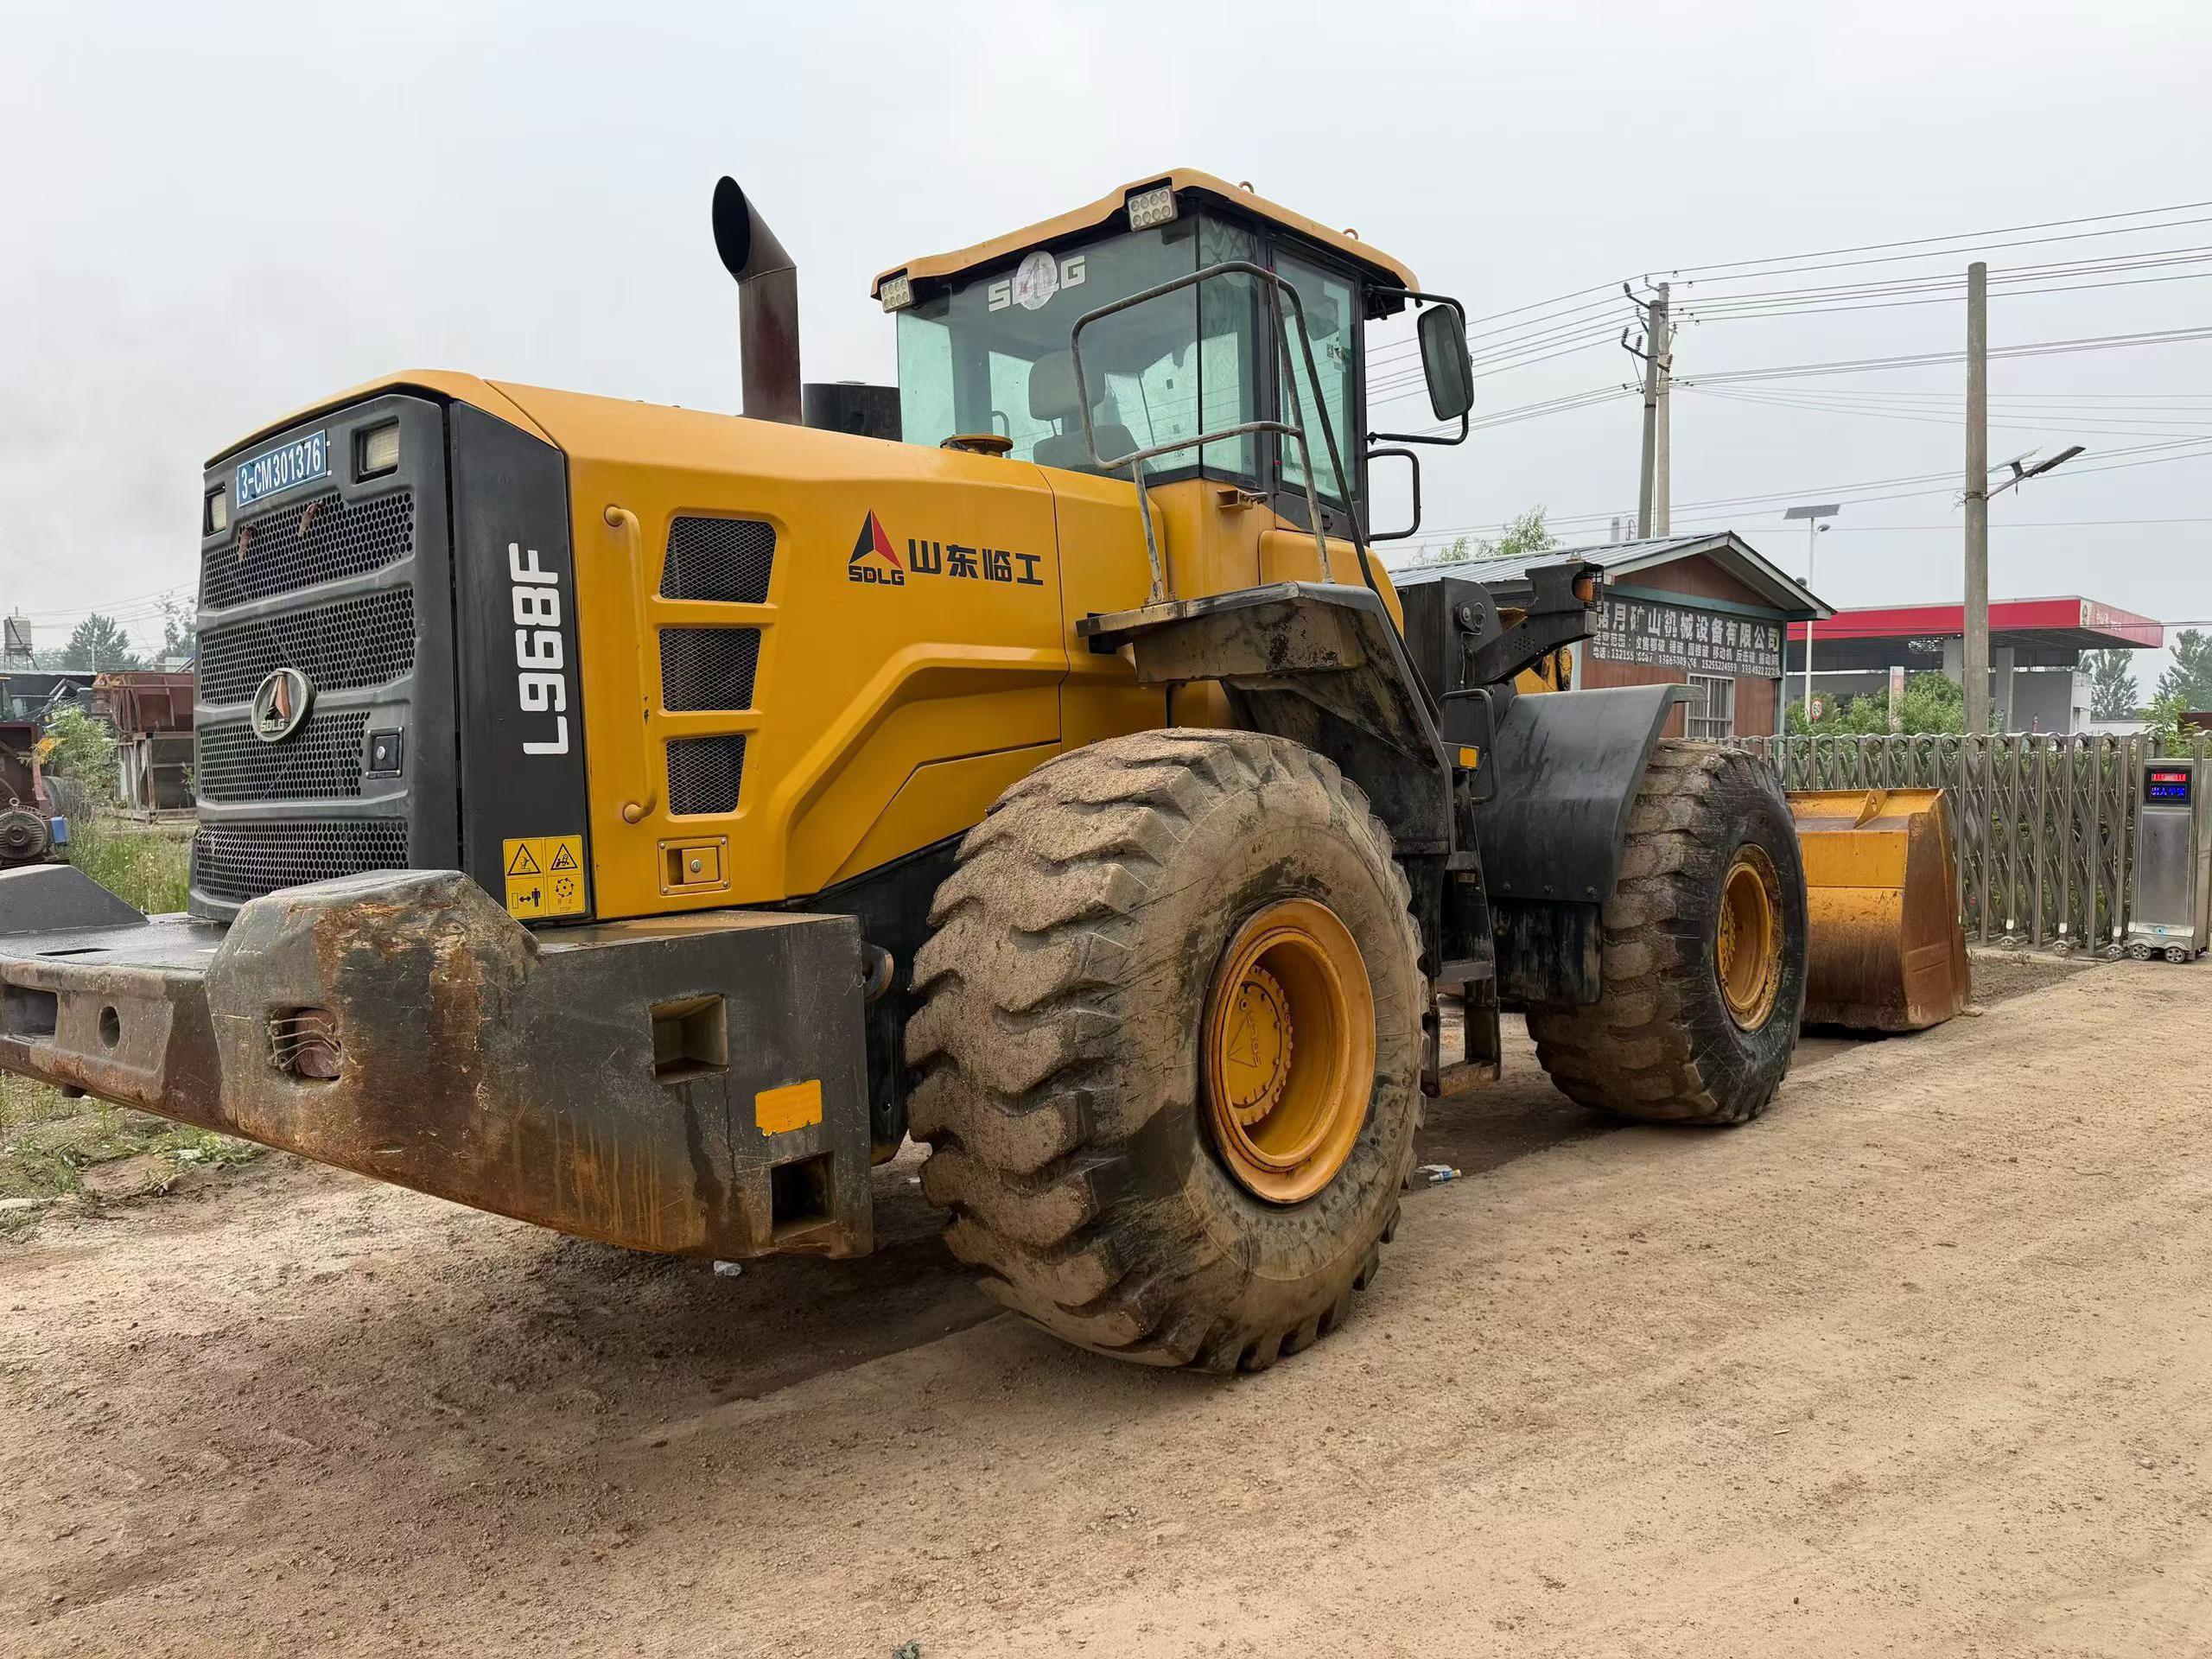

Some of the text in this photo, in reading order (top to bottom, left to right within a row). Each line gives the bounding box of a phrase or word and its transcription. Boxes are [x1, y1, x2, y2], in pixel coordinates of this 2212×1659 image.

[241, 437, 321, 499] 3-CM301376
[849, 565, 905, 586] SDLG
[907, 538, 1044, 586] 山东临工
[508, 543, 569, 755] L968F
[260, 718, 286, 733] SDLG
